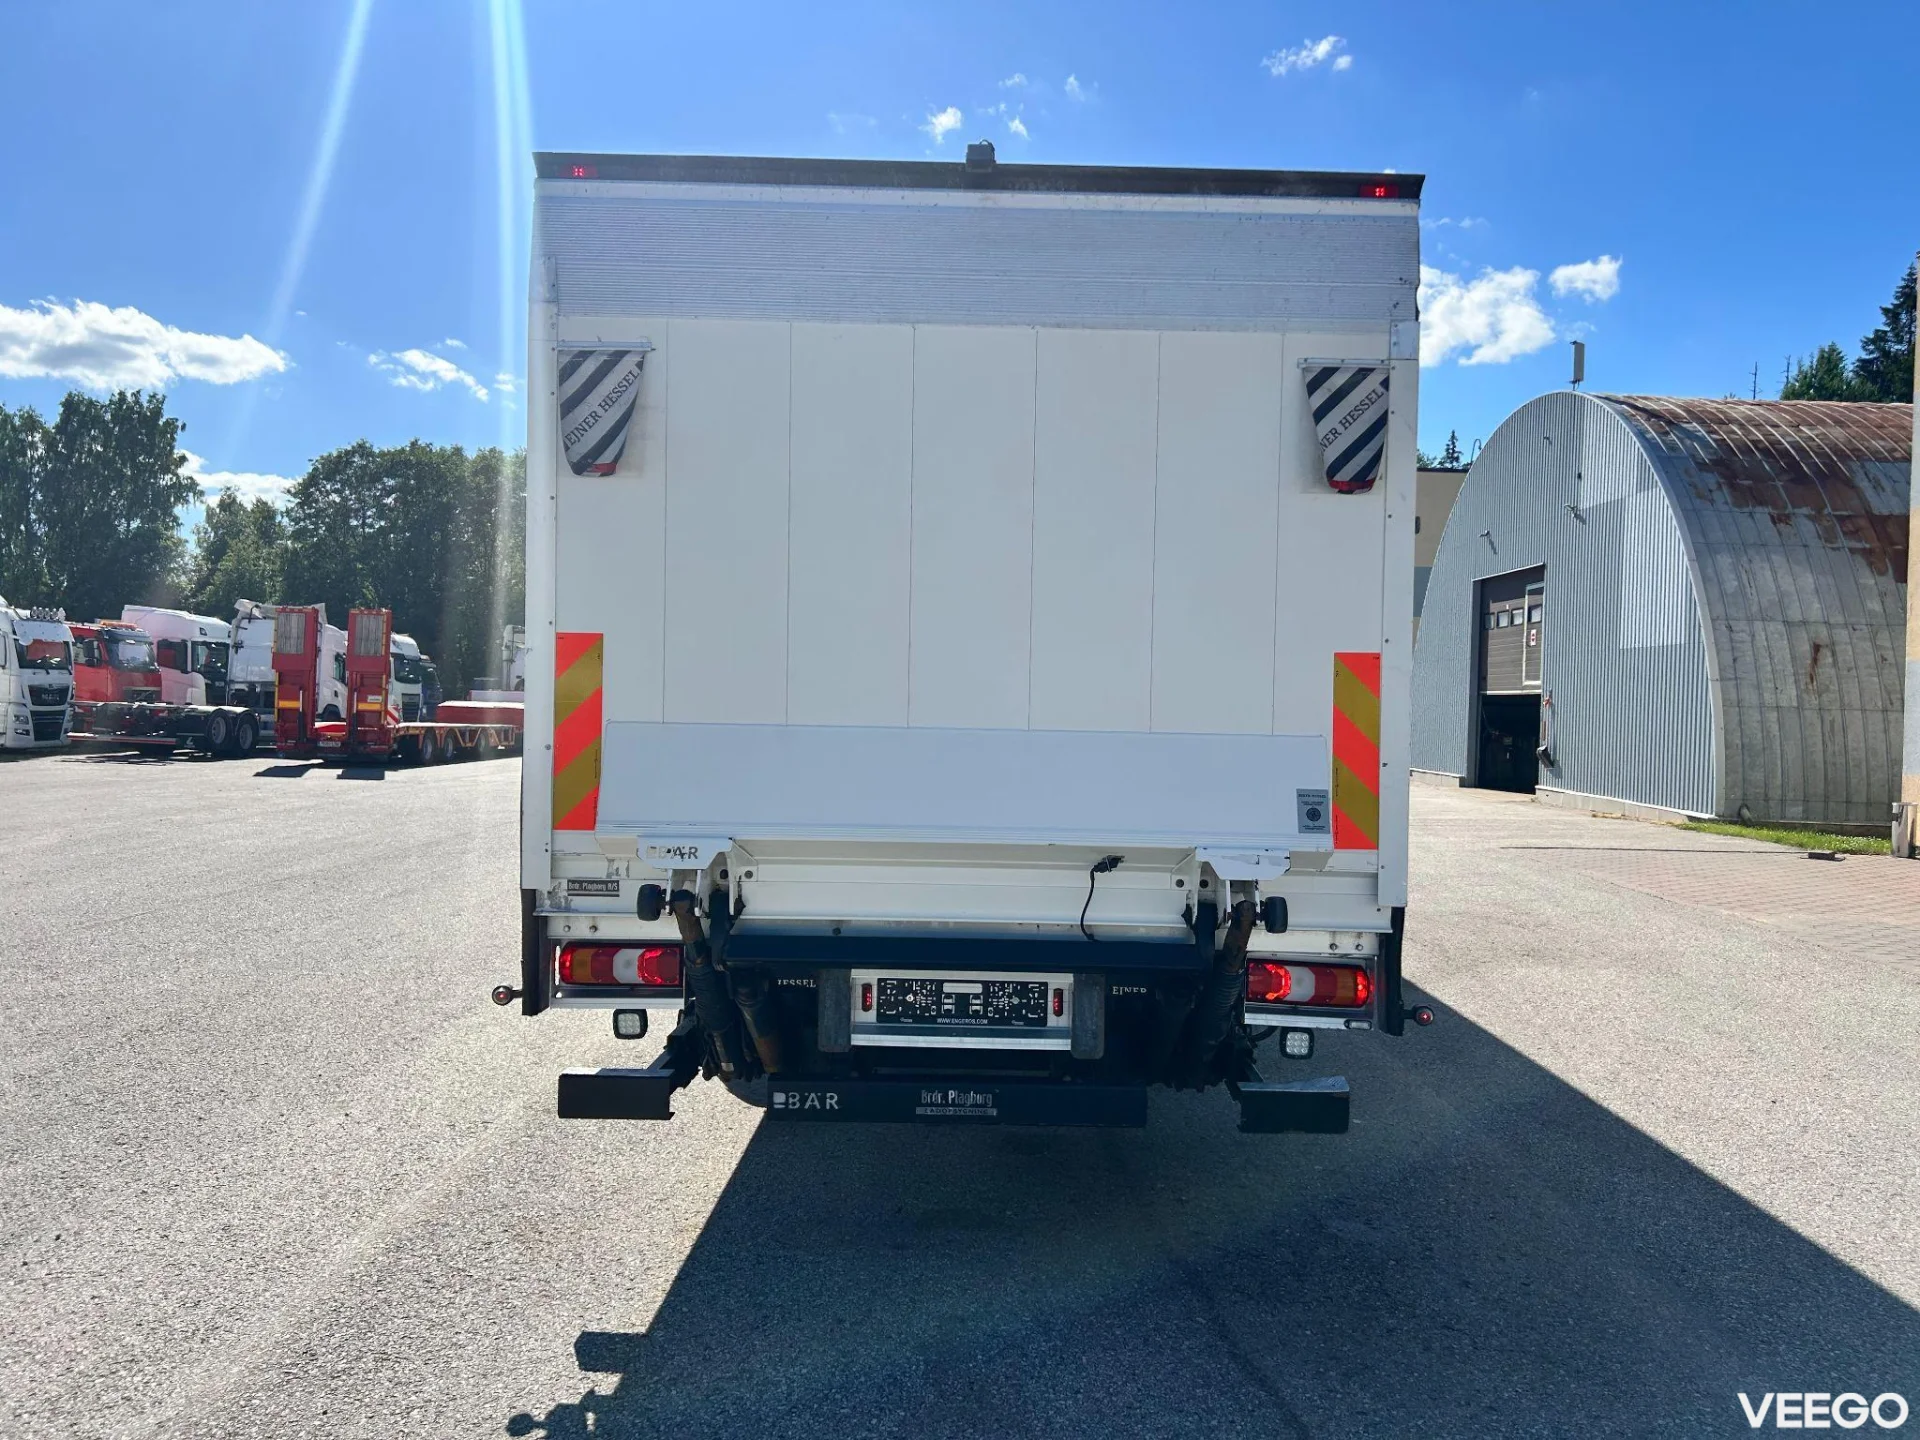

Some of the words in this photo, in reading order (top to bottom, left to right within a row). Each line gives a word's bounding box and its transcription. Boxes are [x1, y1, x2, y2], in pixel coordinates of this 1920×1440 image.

[565, 410, 602, 446] EJNER
[598, 369, 640, 413] HESSEL
[1338, 388, 1384, 431] HESSEL
[921, 1089, 946, 1104] Brdr.
